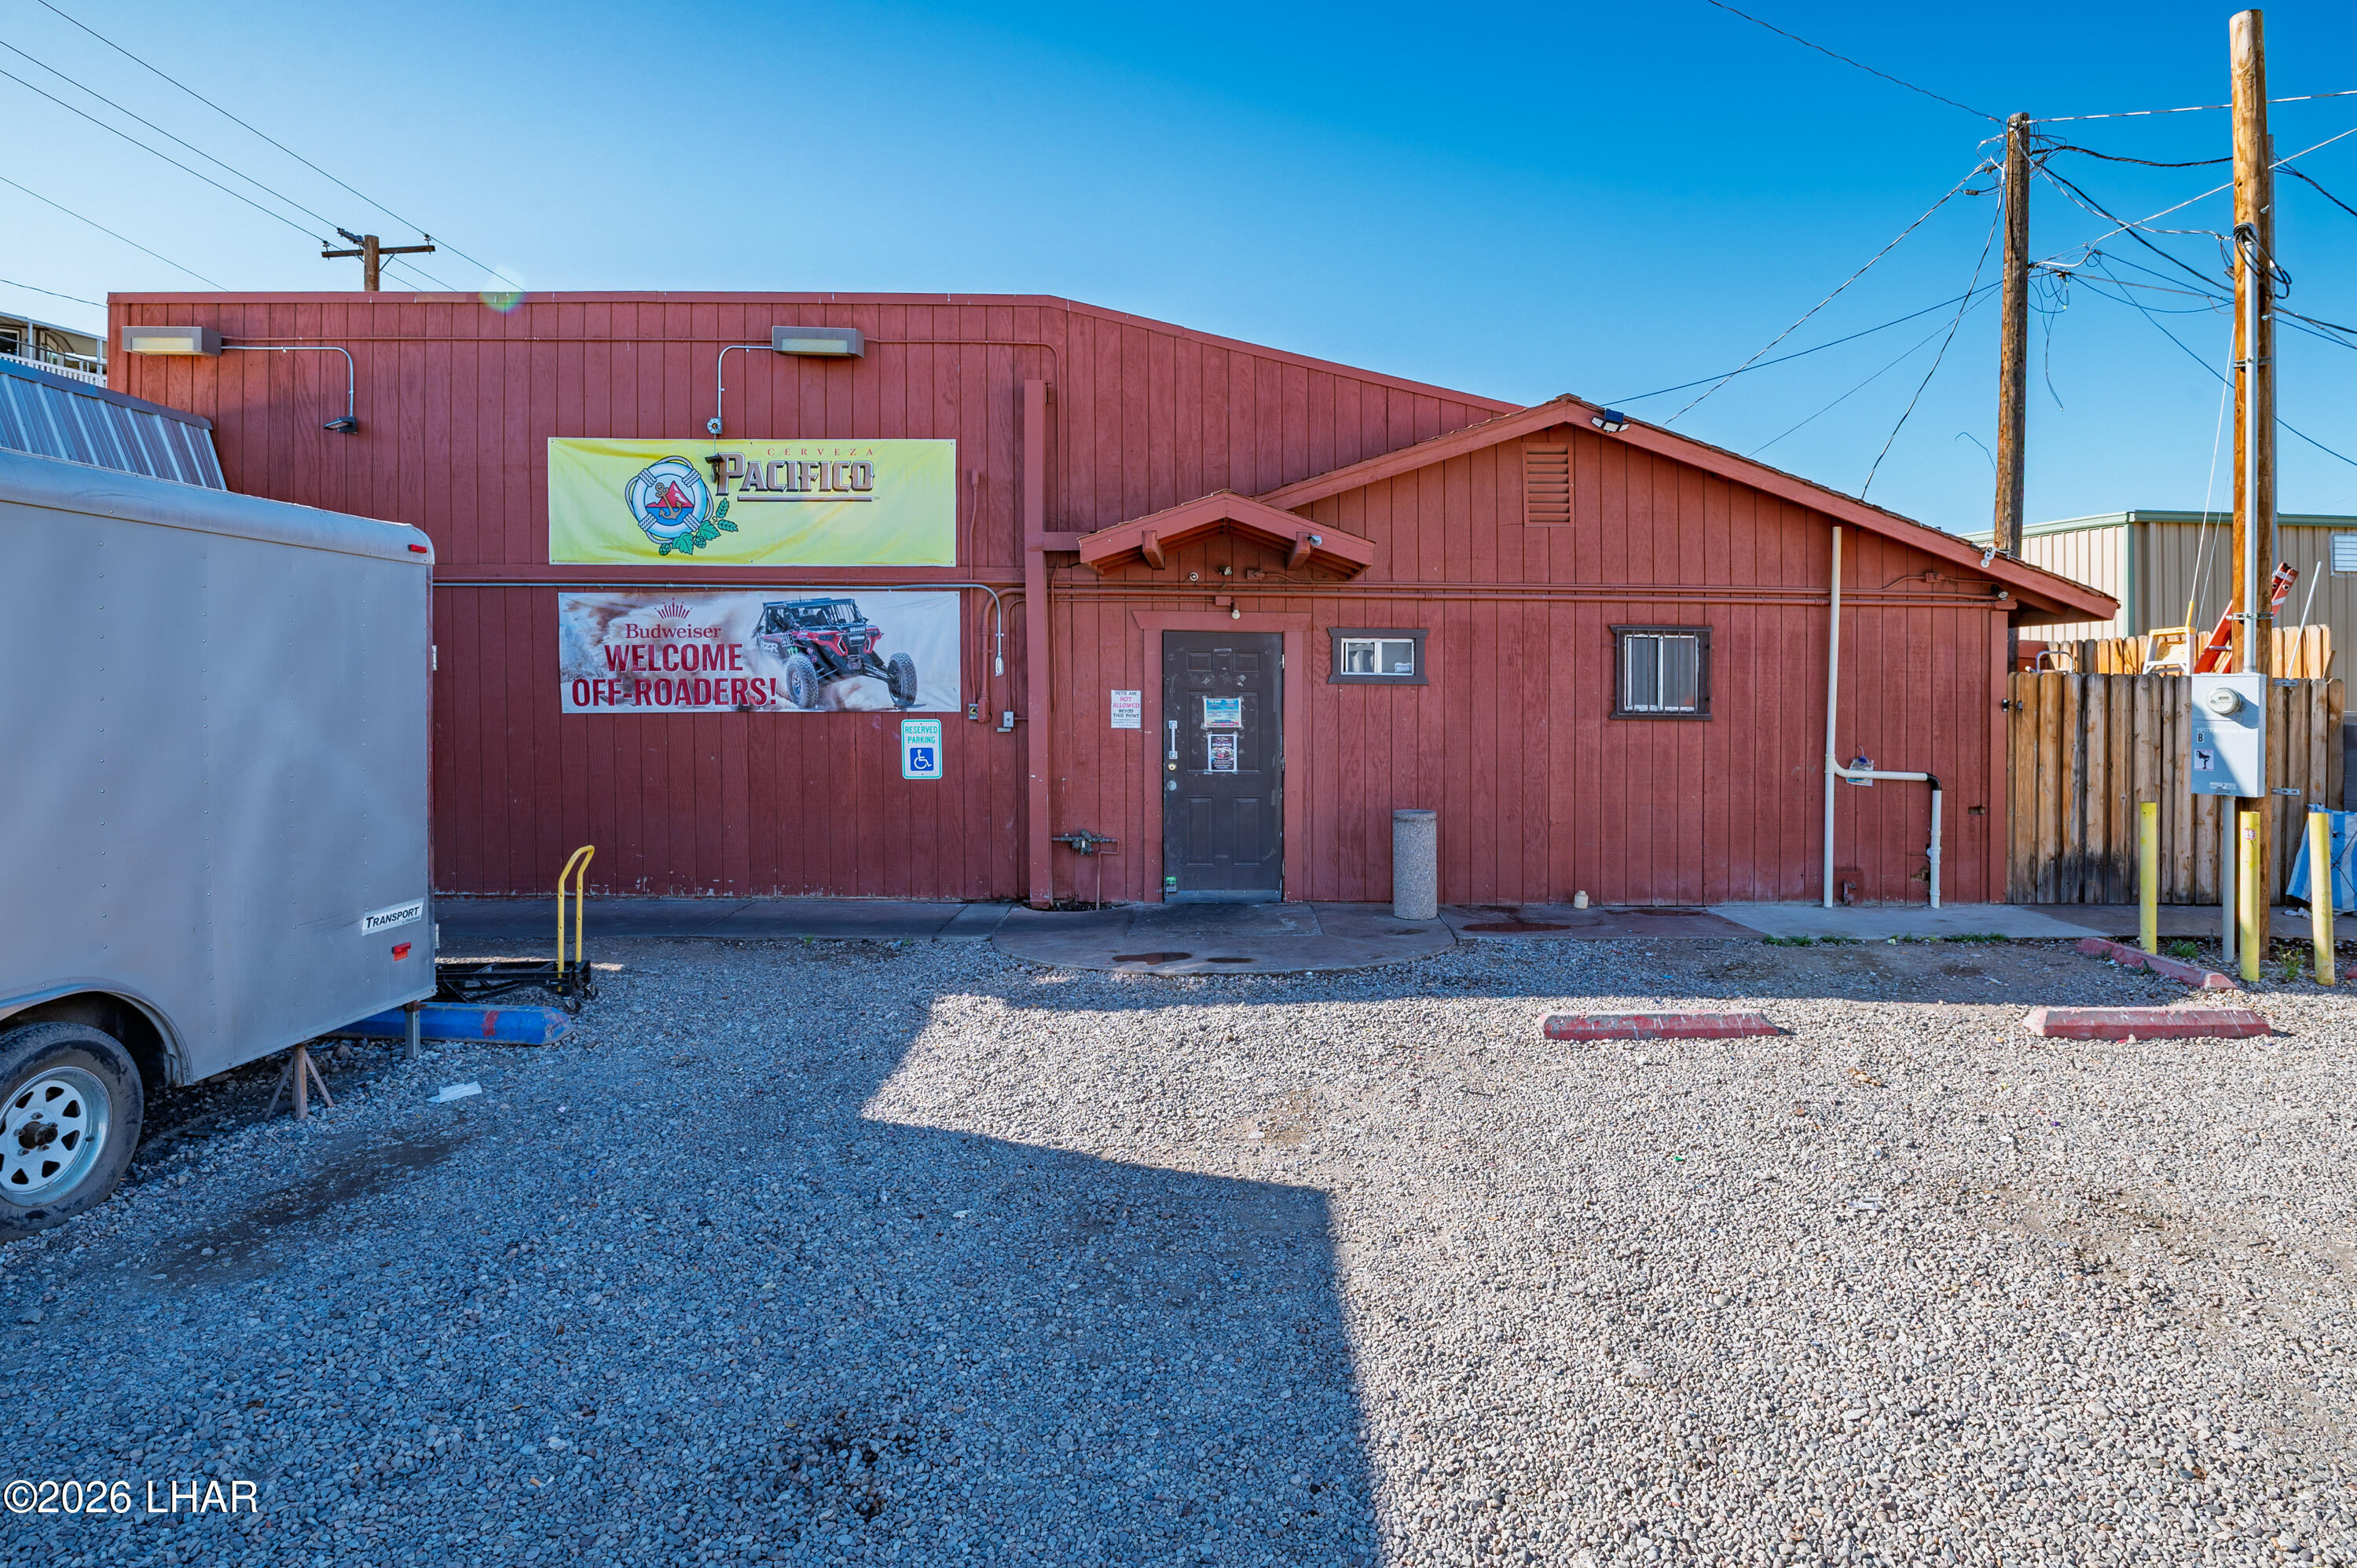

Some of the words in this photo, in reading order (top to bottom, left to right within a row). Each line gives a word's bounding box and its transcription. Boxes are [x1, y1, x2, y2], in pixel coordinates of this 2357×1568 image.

[716, 452, 875, 496] PACIFICO
[625, 623, 722, 639] Budweiser
[603, 643, 743, 672] WELCOME
[572, 677, 777, 707] OFF-ROADERS!
[2198, 733, 2204, 742] B
[365, 907, 420, 929] TRANSPORT
